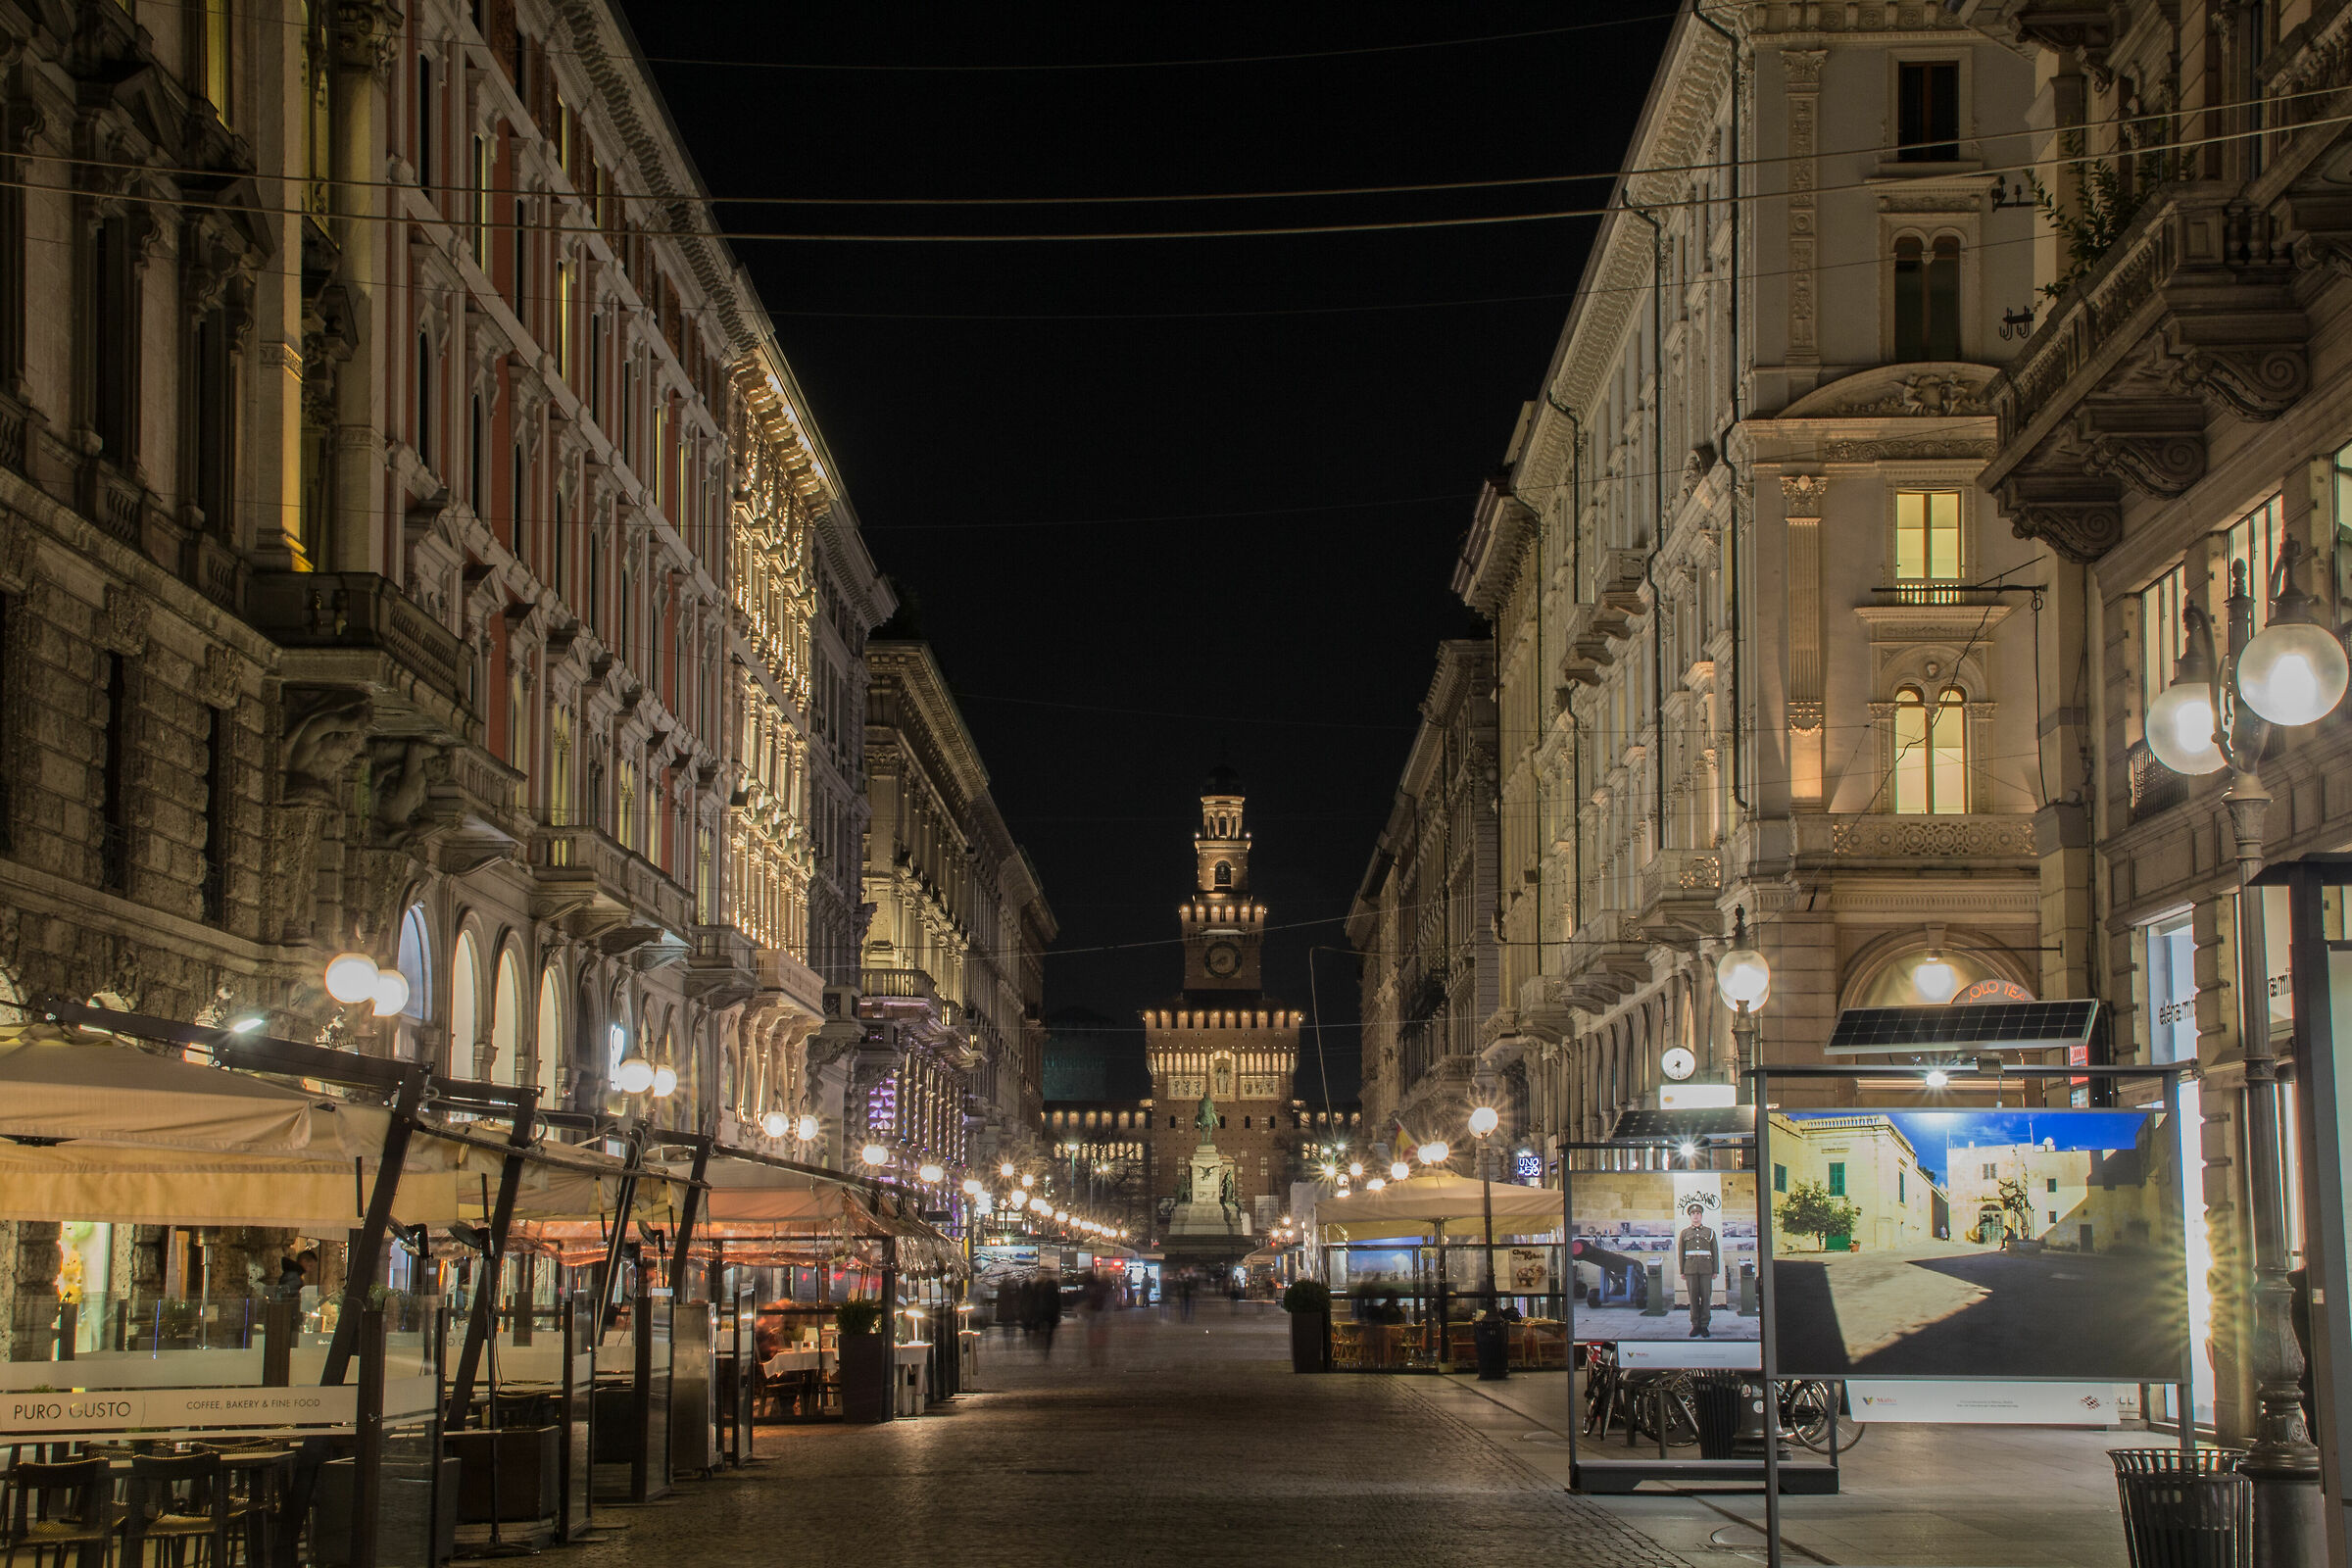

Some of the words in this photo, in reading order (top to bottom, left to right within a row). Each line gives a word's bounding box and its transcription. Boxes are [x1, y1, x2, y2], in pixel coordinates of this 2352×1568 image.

[2003, 982, 2031, 1002] TEA
[1519, 1157, 1539, 1166] UNO
[1525, 1166, 1540, 1176] 50
[186, 1400, 223, 1410] COFFEE,
[225, 1399, 260, 1409] BAKERY
[262, 1398, 269, 1408] &
[270, 1398, 291, 1408] FINE
[294, 1398, 320, 1408] FOOD
[14, 1403, 62, 1420] PURO
[69, 1401, 131, 1419] GUSTO
